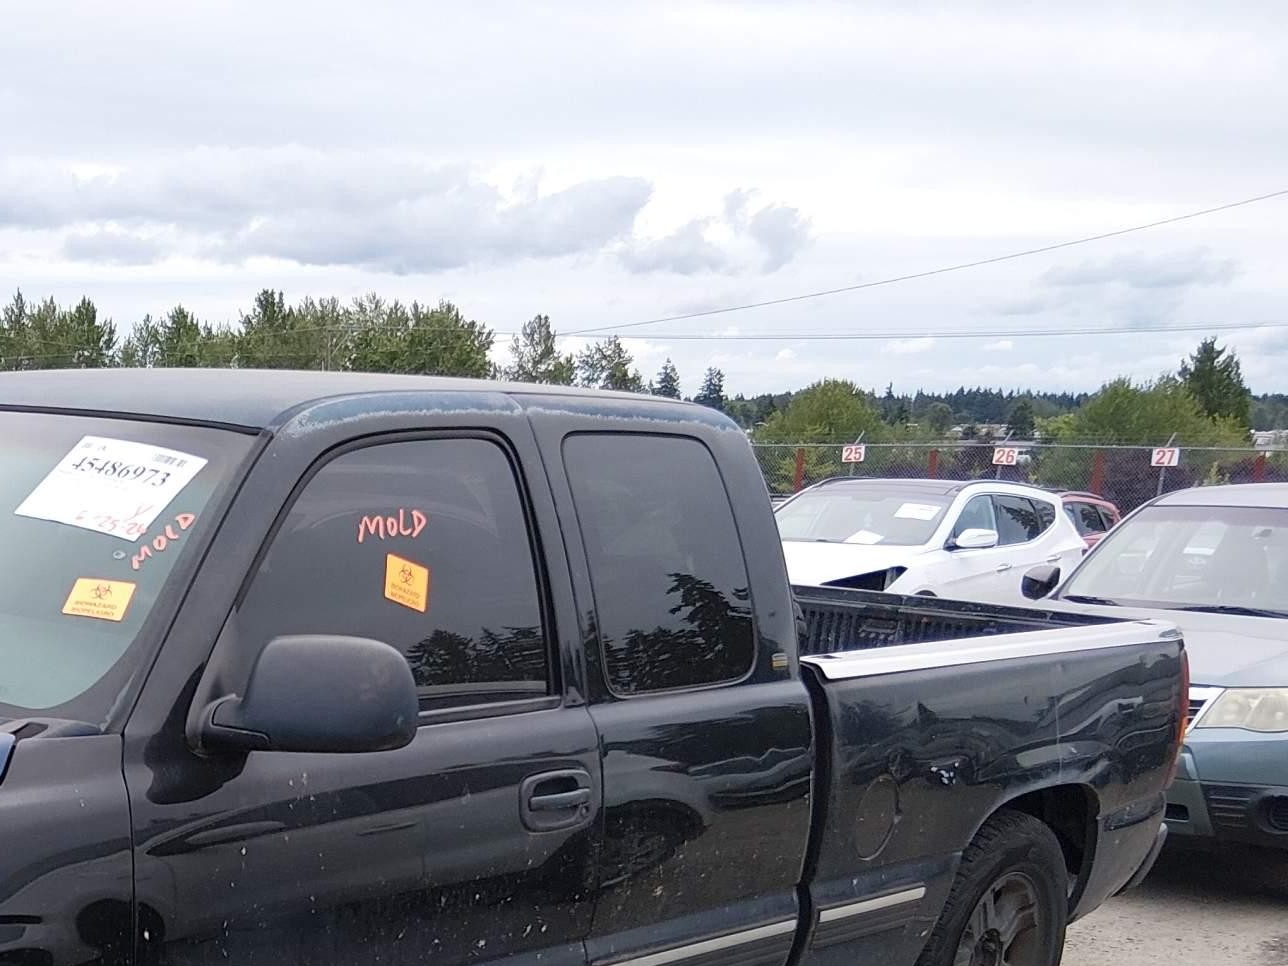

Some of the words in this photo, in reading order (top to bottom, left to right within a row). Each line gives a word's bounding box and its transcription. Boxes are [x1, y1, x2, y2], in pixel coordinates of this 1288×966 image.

[844, 447, 862, 461] 25
[995, 449, 1016, 464] 26
[1155, 450, 1175, 465] 27
[72, 456, 171, 487] 45486973
[358, 508, 427, 543] MOLD
[132, 513, 195, 570] MOLD
